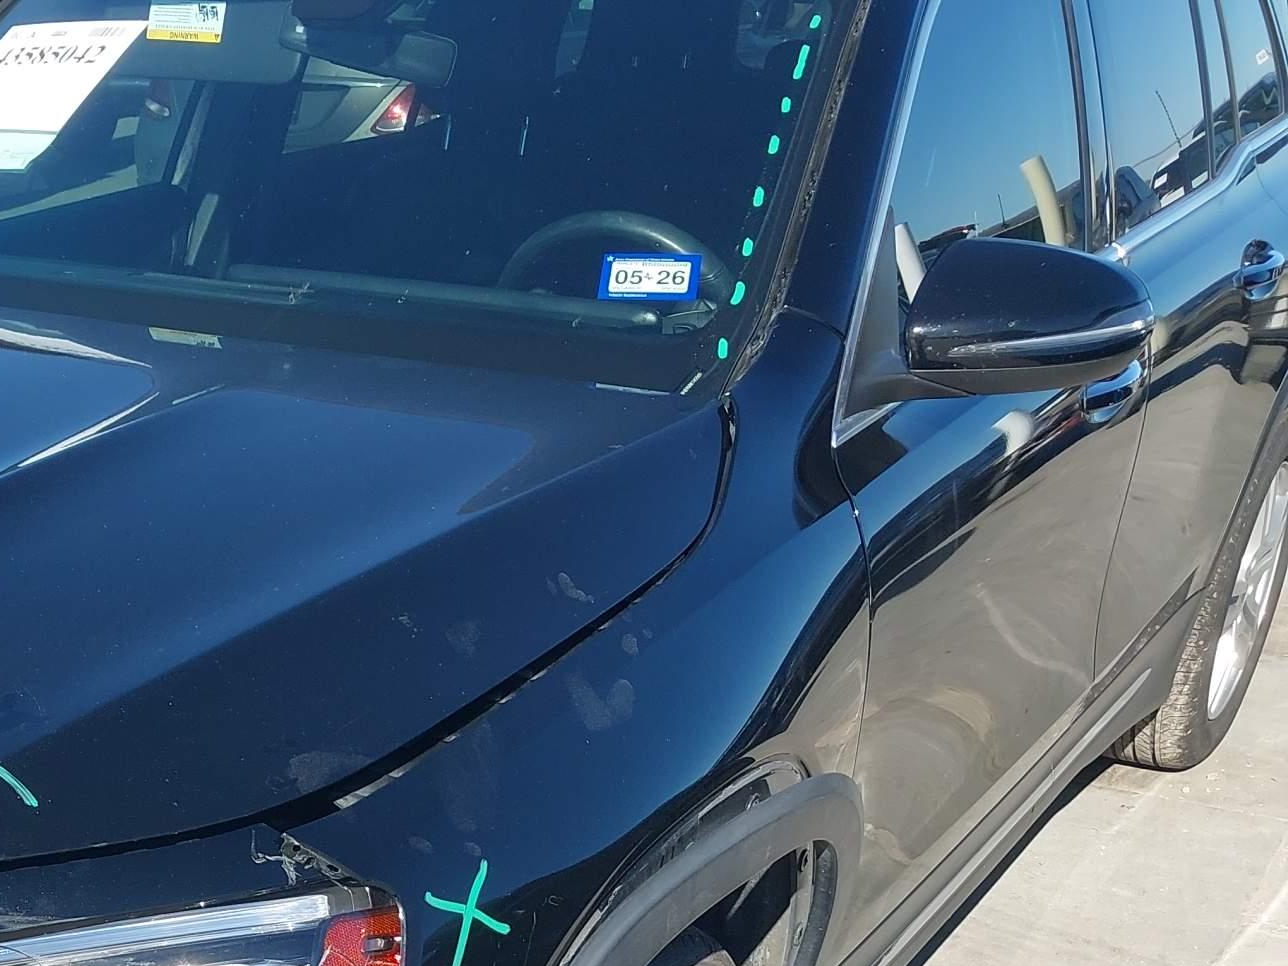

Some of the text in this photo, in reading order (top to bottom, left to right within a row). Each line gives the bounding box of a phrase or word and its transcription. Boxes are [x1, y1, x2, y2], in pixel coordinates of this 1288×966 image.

[169, 32, 199, 41] WARNING
[615, 269, 685, 285] 05 26
